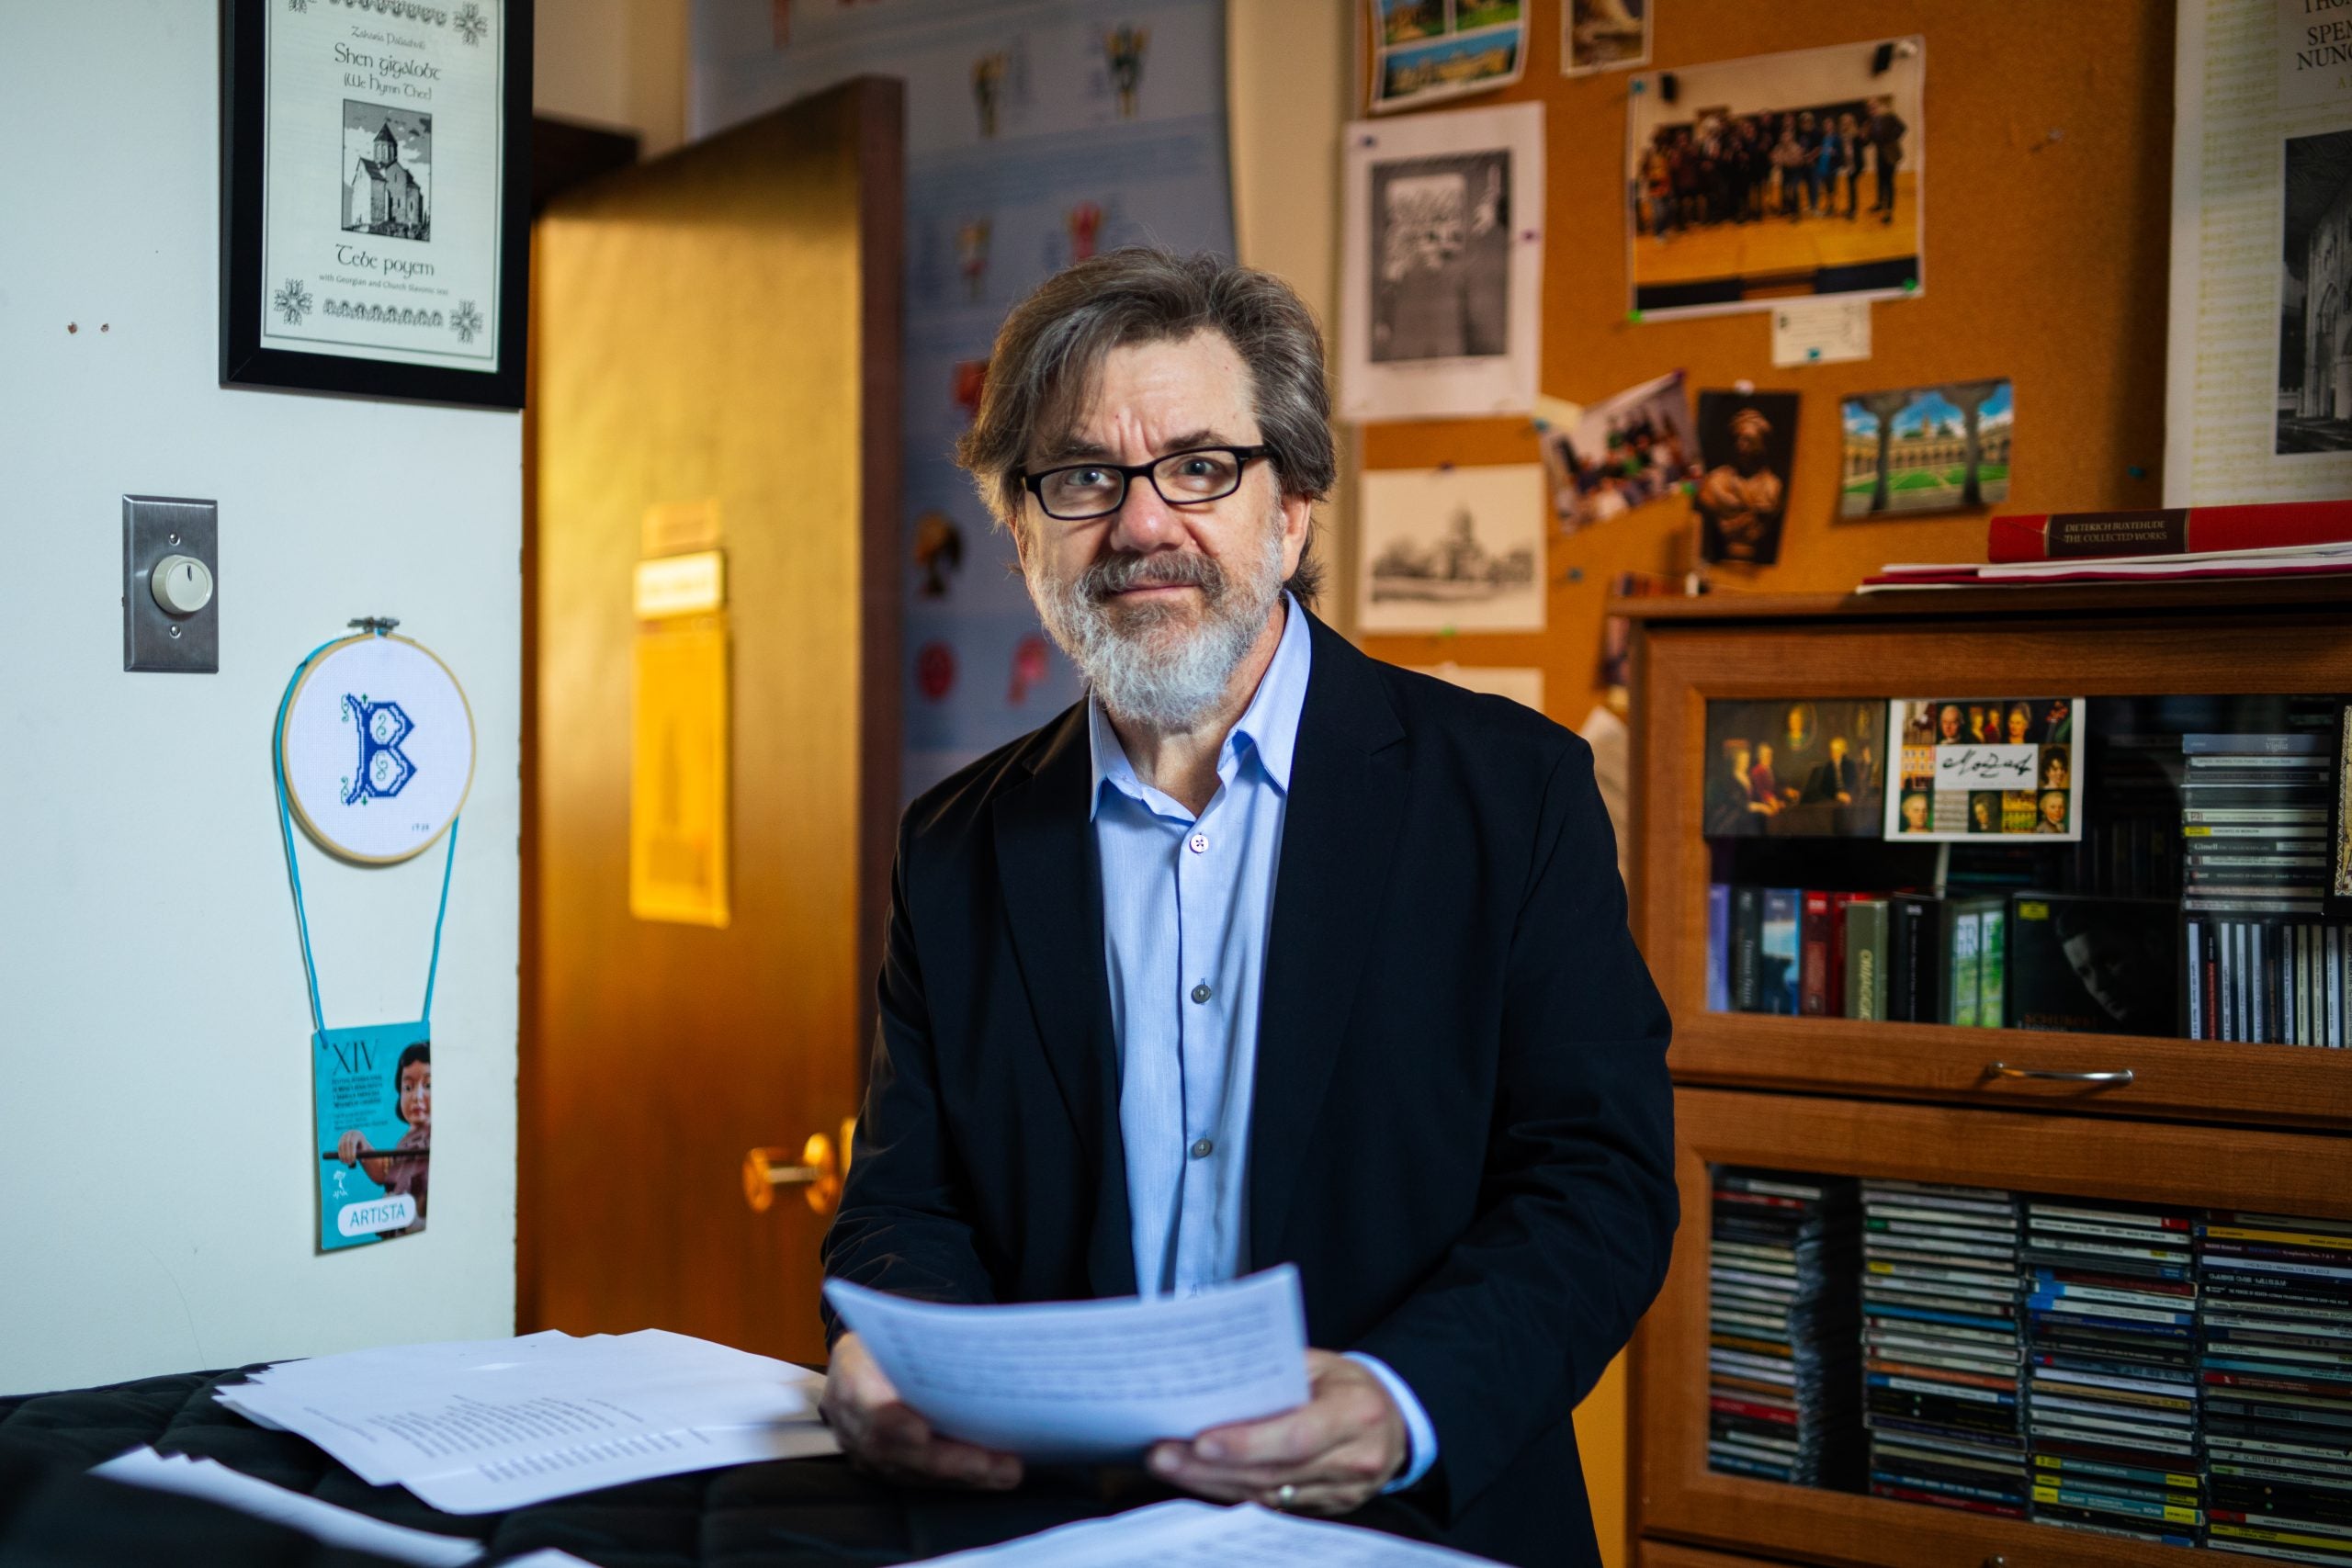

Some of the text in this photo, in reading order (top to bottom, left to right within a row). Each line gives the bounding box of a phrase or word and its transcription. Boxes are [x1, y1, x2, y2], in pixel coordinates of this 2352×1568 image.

[334, 42, 441, 81] Shen gigalobe
[2297, 43, 2352, 71] NUN
[335, 243, 435, 279] Tebe poyem
[319, 274, 334, 282] with
[336, 275, 367, 287] Georgian
[368, 279, 381, 288] and
[2064, 531, 2168, 544] THE COLLECTED WORKS
[2065, 520, 2165, 533] DIETERICH BUXTEHUDE
[333, 1039, 379, 1076] XIV
[350, 1202, 405, 1227] ARTISTA
[2243, 1455, 2281, 1464] SCHUBERT
